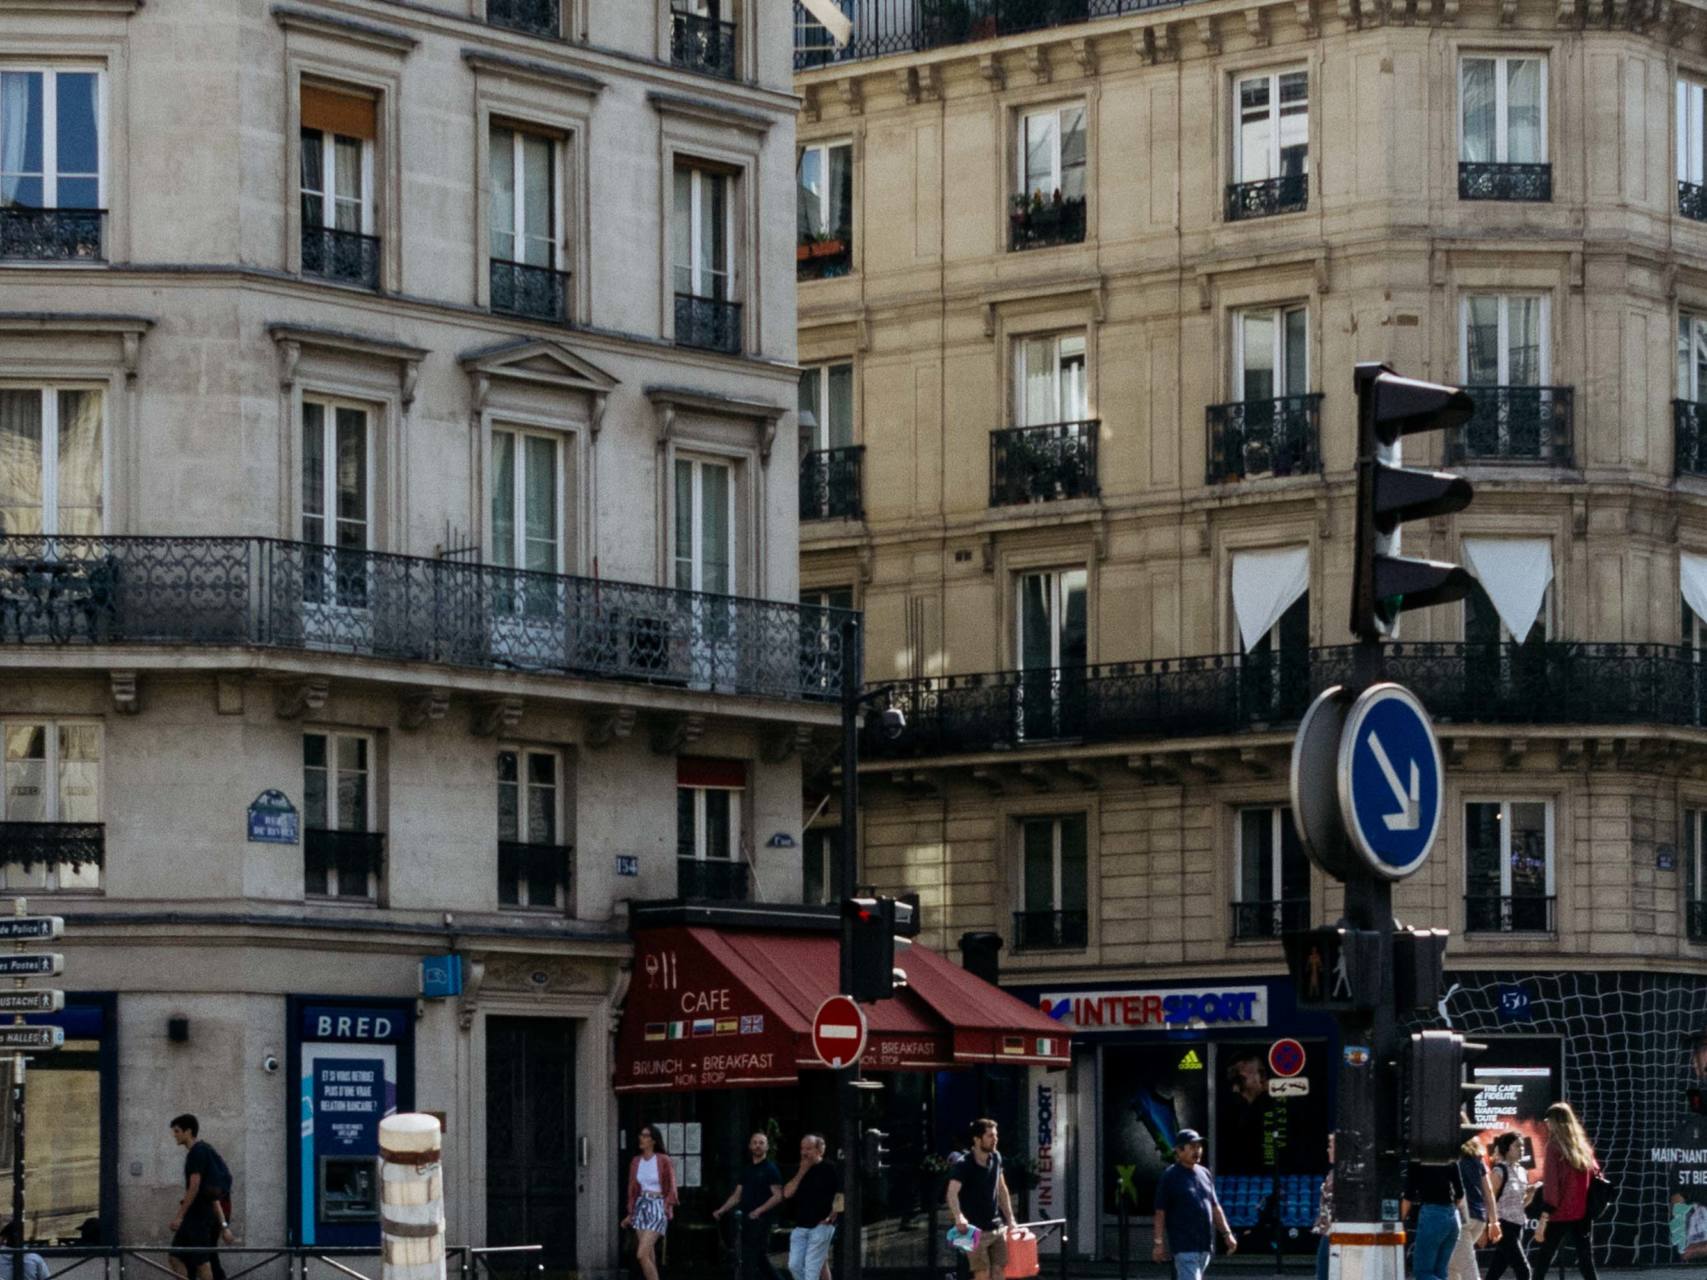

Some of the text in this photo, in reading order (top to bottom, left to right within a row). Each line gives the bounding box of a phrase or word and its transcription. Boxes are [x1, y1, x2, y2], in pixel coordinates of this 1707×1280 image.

[0, 997, 39, 1007] USTACHE
[681, 989, 730, 1013] CAFE
[1074, 992, 1257, 1025] INTERSPORT
[317, 1015, 392, 1038] BRED
[881, 1042, 935, 1055] BREAKFAST
[633, 1059, 683, 1076] BRUNCH
[703, 1053, 773, 1071] BREAKFAST
[860, 1056, 877, 1065] ON
[675, 1072, 726, 1085] NON STOP
[1038, 1084, 1053, 1206] INTERSPORT
